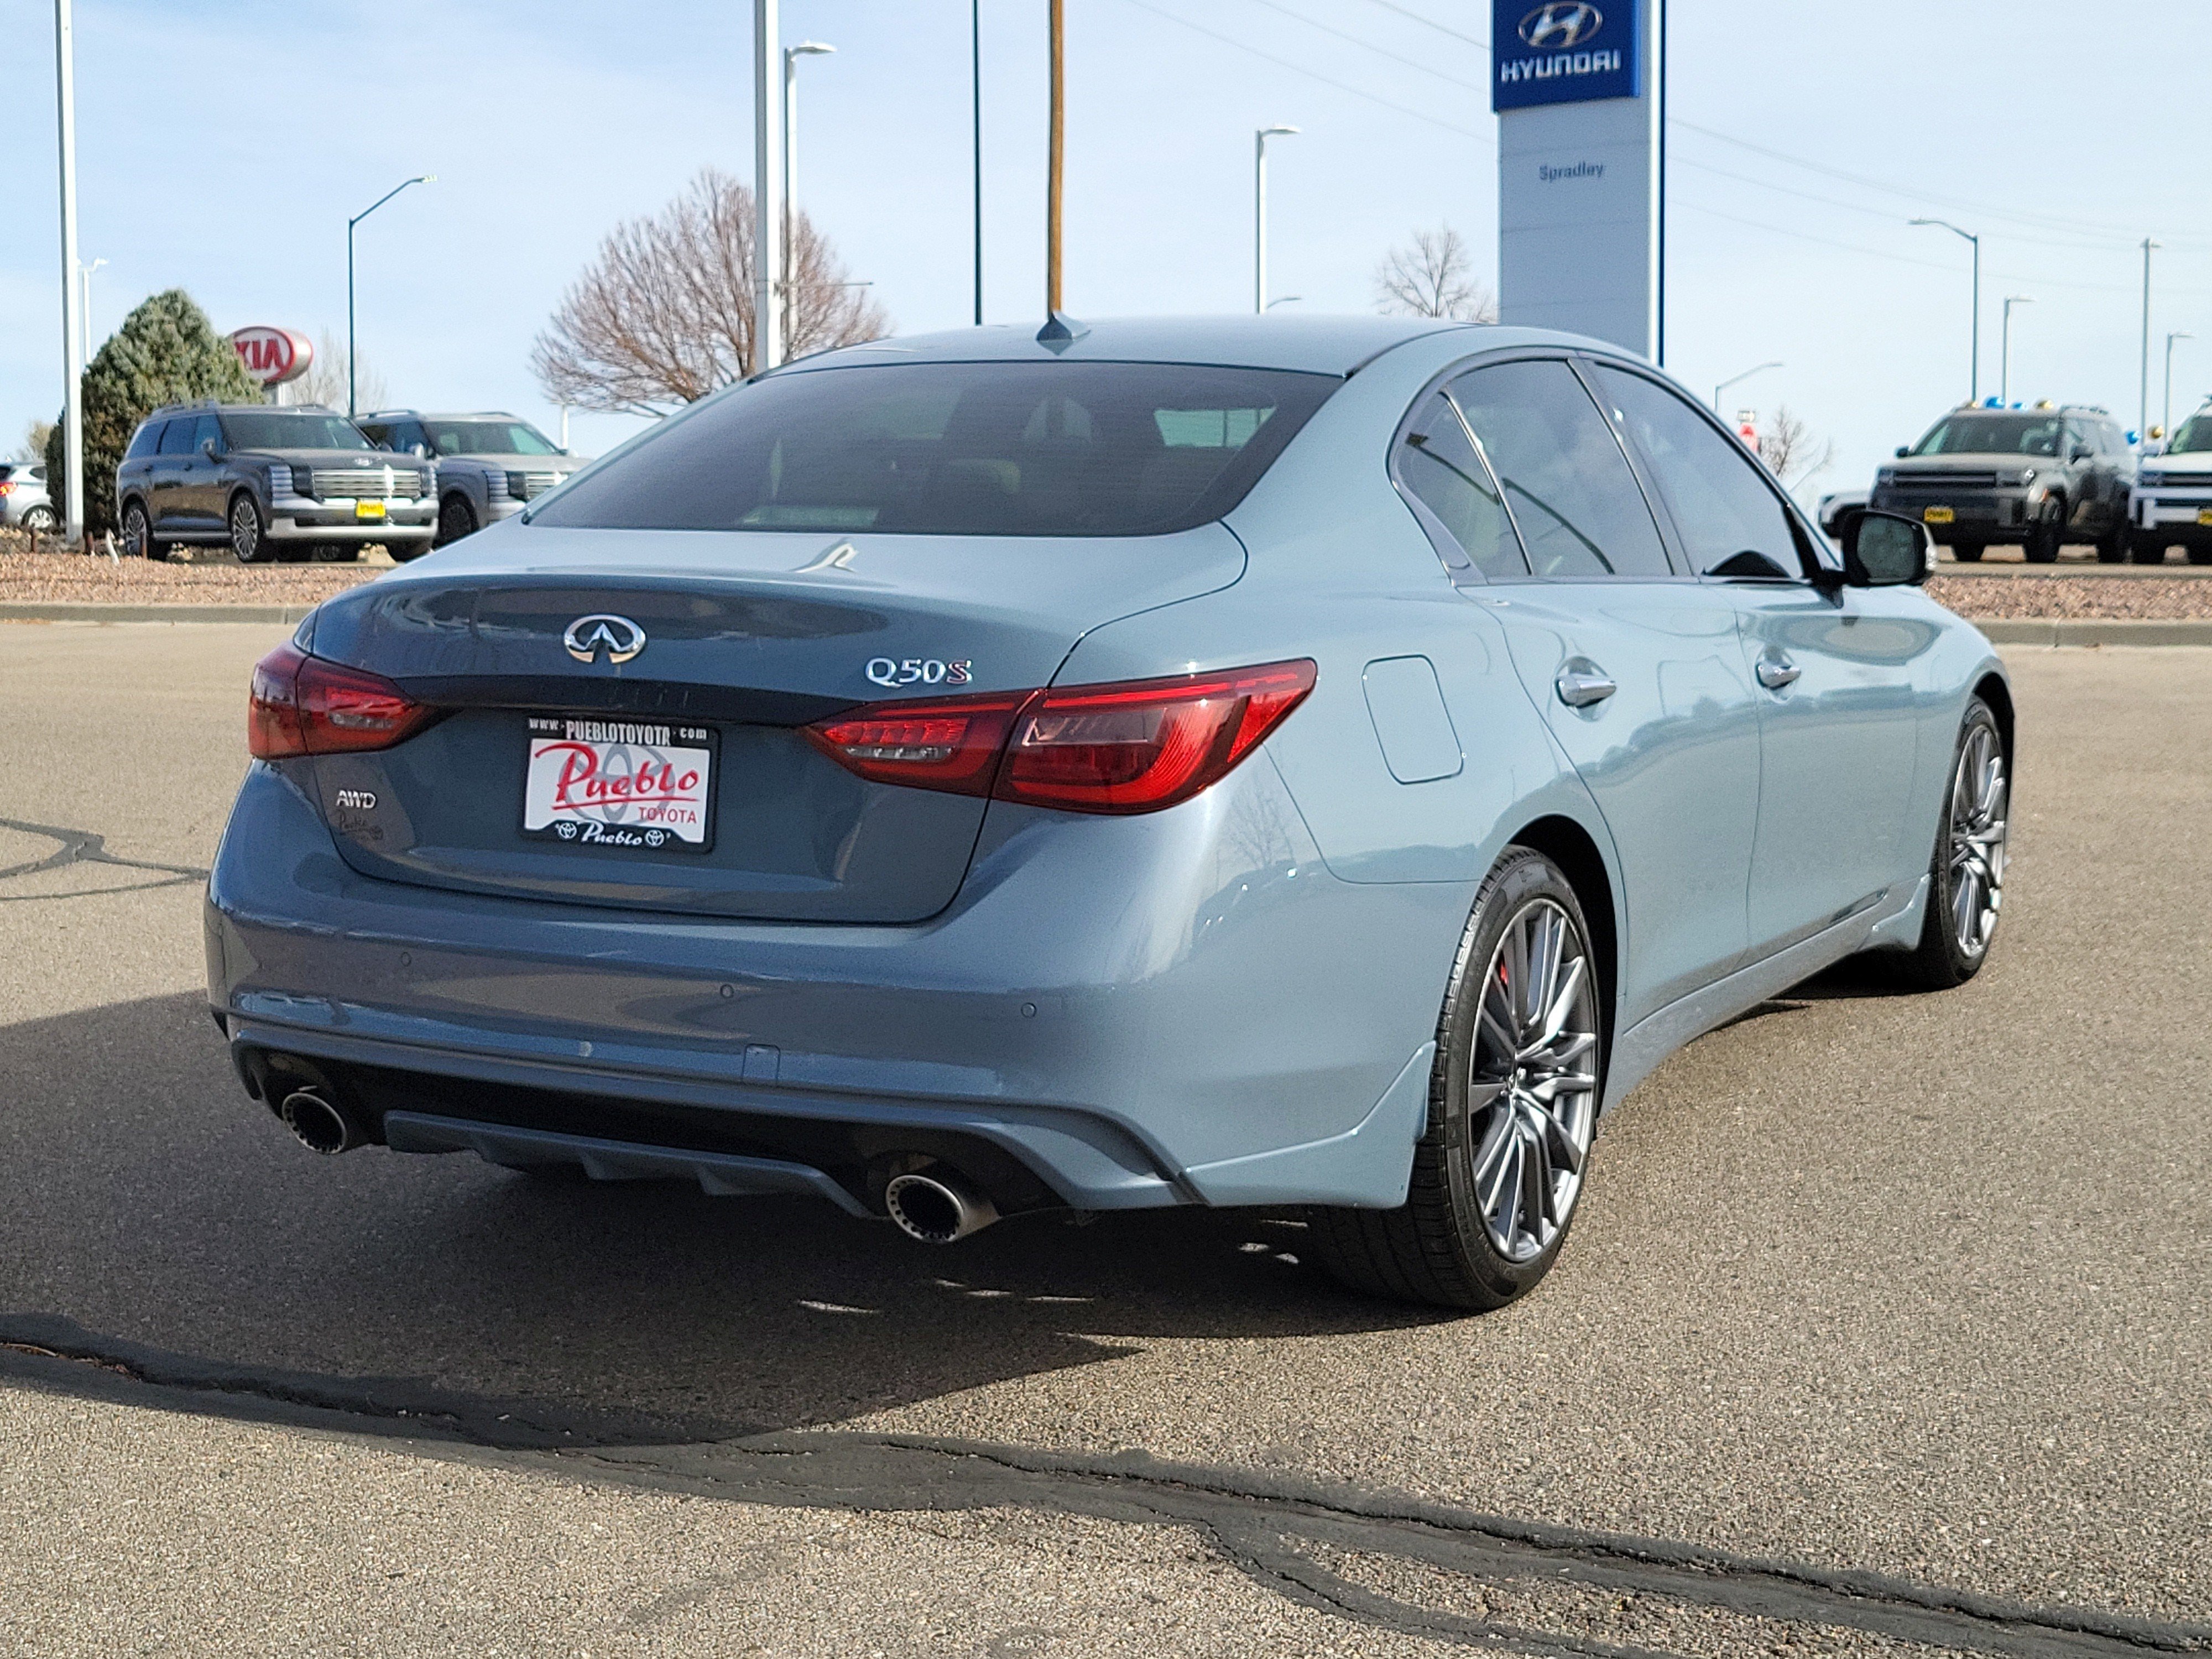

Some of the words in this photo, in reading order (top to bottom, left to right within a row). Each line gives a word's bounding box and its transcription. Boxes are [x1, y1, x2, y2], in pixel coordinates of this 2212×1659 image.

[1501, 49, 1621, 82] HYUNDAI
[1539, 161, 1604, 182] Spradley
[865, 657, 972, 688] Q50S
[534, 742, 699, 802] Pueblo
[336, 790, 377, 809] AWD
[638, 807, 697, 824] TOYOTA
[576, 822, 643, 846] Pueblo
